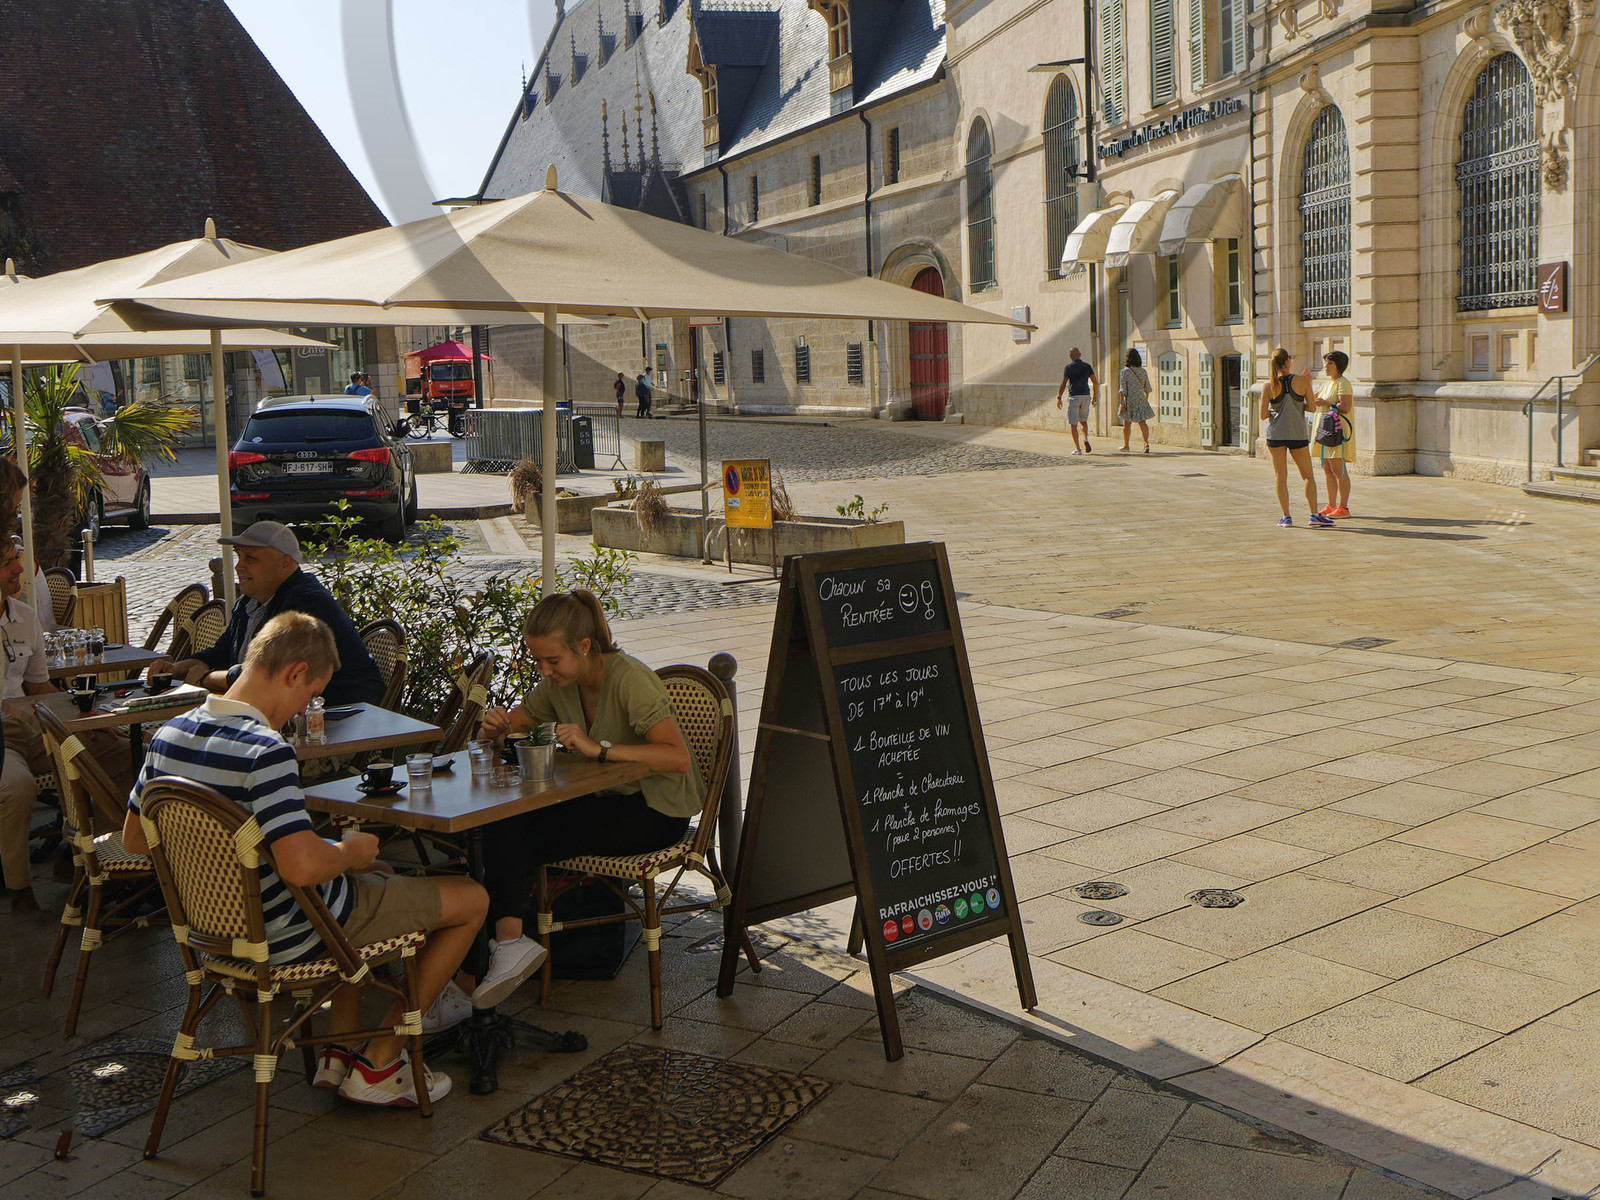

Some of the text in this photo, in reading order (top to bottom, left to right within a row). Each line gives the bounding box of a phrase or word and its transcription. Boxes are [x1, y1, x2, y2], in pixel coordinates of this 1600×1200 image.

[876, 578, 891, 592] sa
[840, 601, 894, 628] RENTRÉE
[840, 664, 939, 692] TOUS LES JOURS
[847, 701, 865, 722] DE
[895, 692, 903, 709] à
[853, 723, 951, 752] 1 BOUTEILLE DE VIN
[877, 745, 921, 769] ACHETÉE
[861, 790, 873, 806] 1
[873, 783, 905, 804] Planche
[909, 780, 919, 796] de
[871, 798, 981, 833] 1 Planche de fromages
[912, 827, 920, 841] 2
[879, 876, 989, 920] RAFRAICHISSEZ-VOUS
